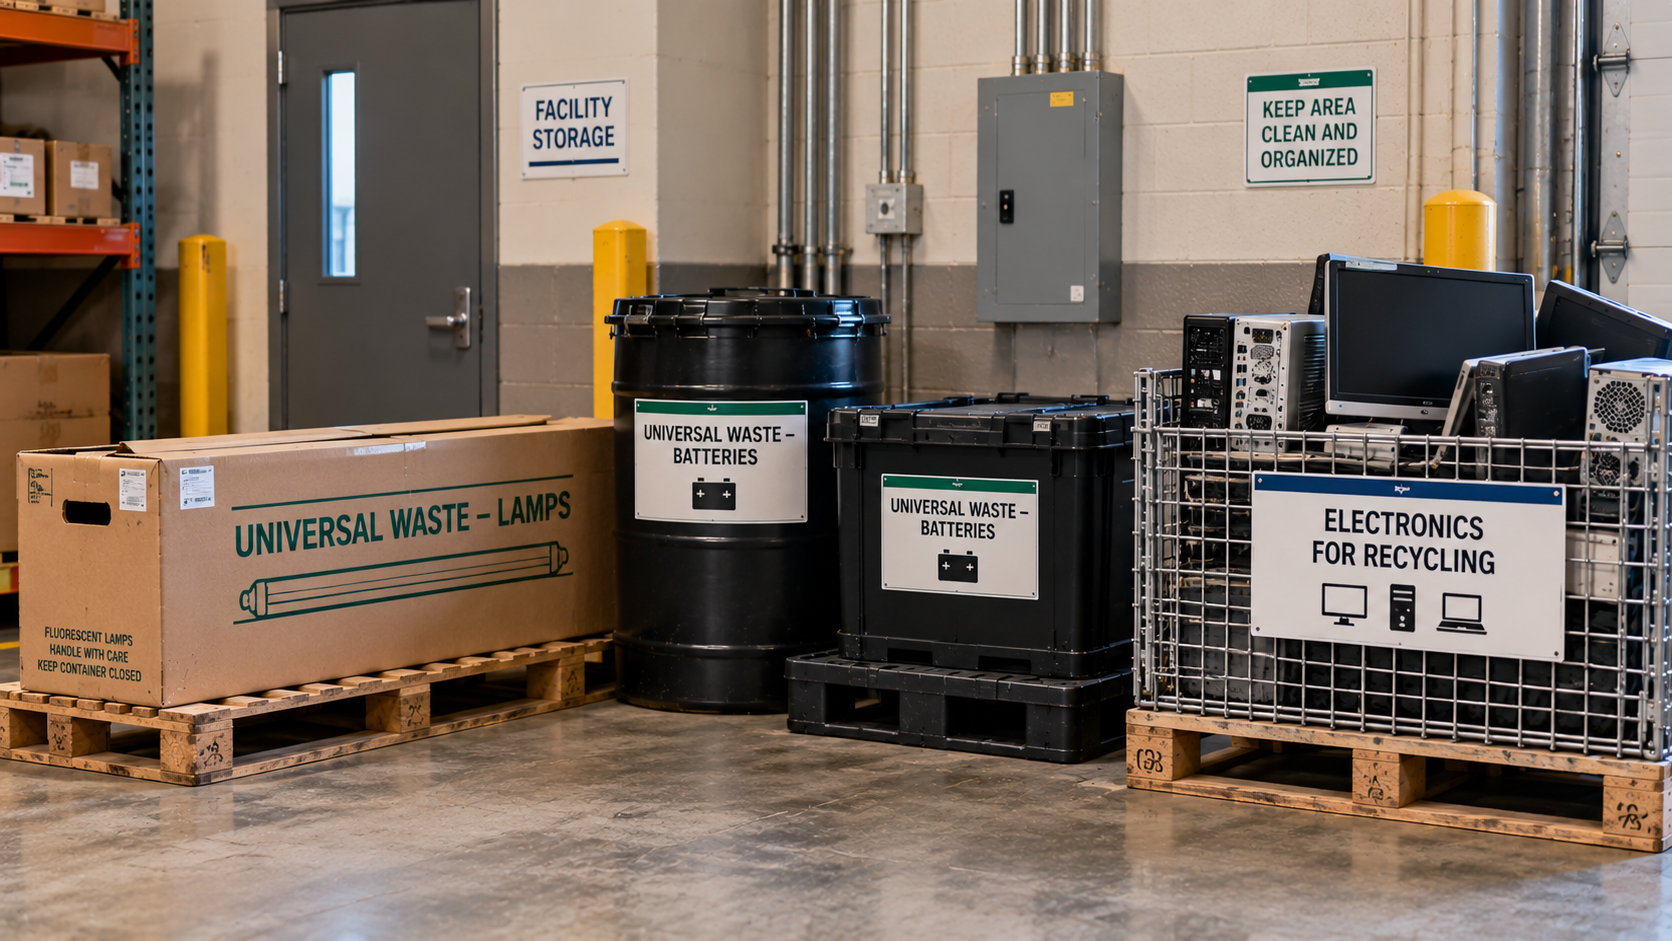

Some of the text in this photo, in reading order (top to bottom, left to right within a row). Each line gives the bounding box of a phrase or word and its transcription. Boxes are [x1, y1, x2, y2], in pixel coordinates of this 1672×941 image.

[536, 96, 613, 121] FACILITY
[1263, 97, 1356, 118] KEEP AREA
[532, 126, 615, 149] STORAGE
[1261, 123, 1358, 143] CLEAN AND
[1260, 148, 1359, 168] ORGANIZED
[644, 425, 723, 442] UNIVERSAL
[726, 426, 781, 442] WASTE
[673, 448, 758, 465] BATTERIES
[890, 498, 965, 516] UNIVERSAL
[968, 502, 1017, 519] WASTE
[235, 512, 384, 557] UNIVERSAL
[389, 502, 470, 539] WASTE
[497, 491, 572, 526] LAMPS
[920, 520, 996, 539] BATTERIES
[1324, 508, 1484, 540] ELECTRONICS
[1312, 541, 1495, 574] FOR RECYCLING
[44, 627, 134, 646] FLUORESCENT LAMPS
[49, 644, 129, 663] HANDLE WITH CARE
[37, 660, 142, 682] KEEP CONTAINER CLOSED
